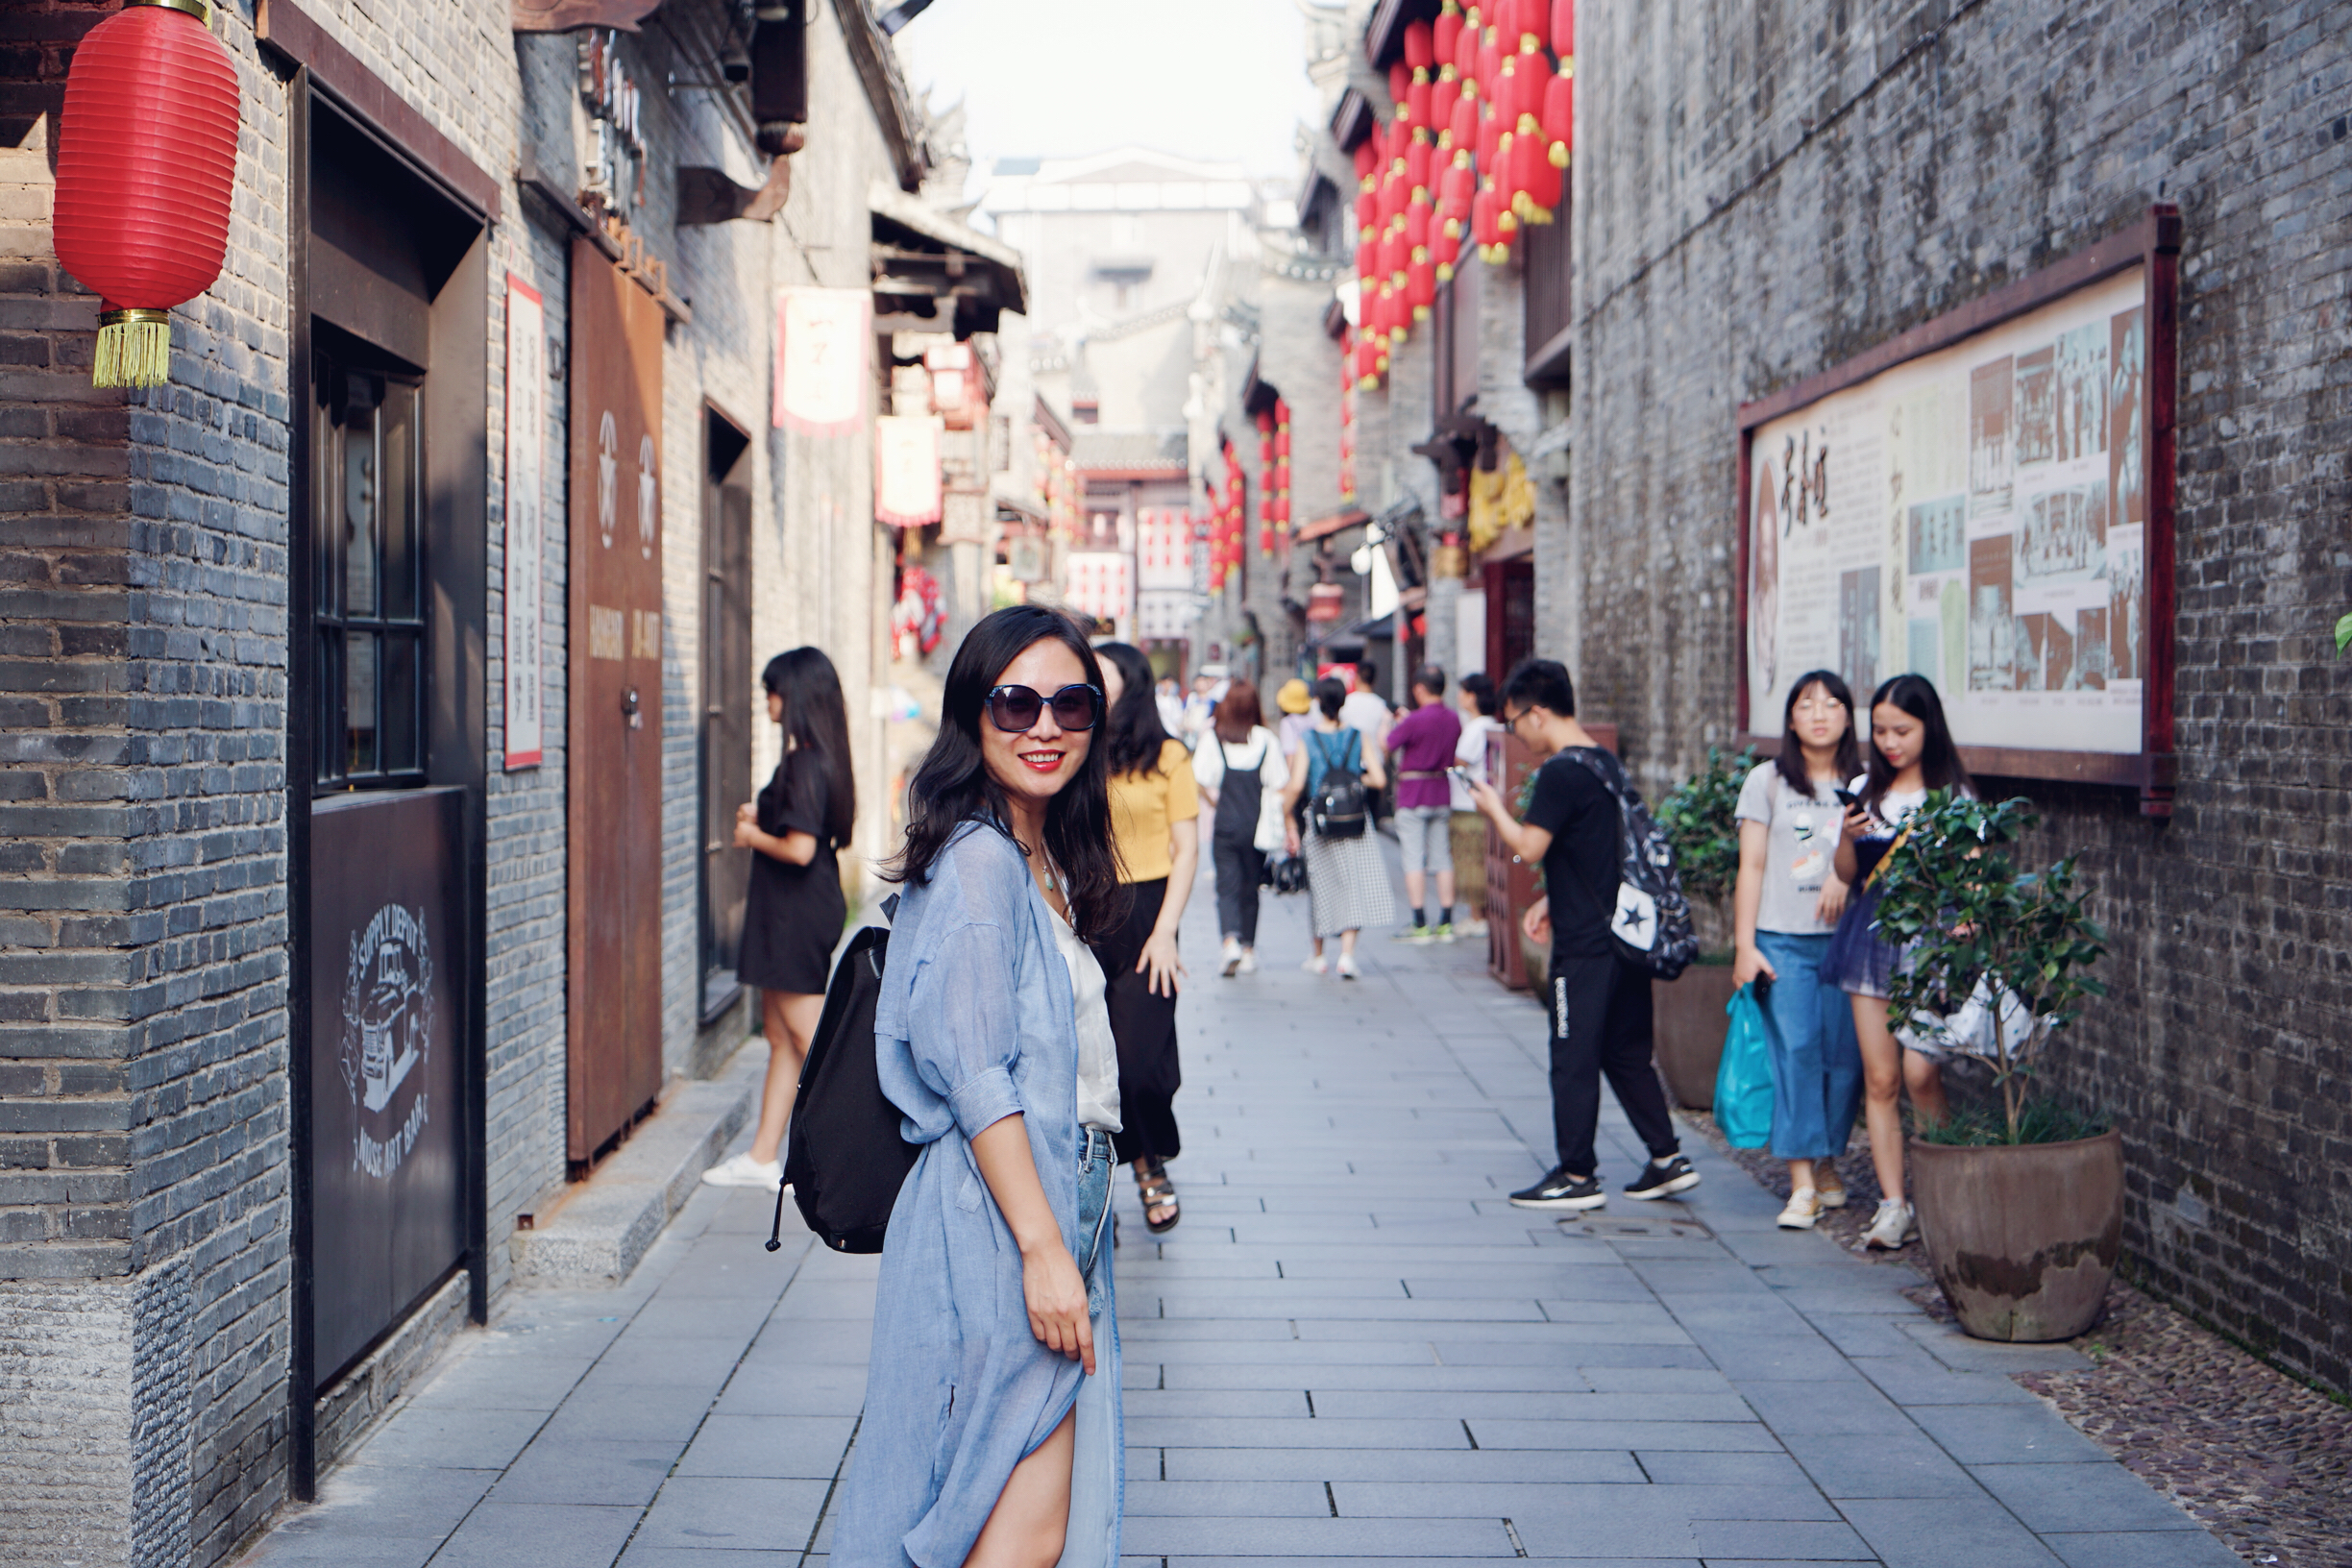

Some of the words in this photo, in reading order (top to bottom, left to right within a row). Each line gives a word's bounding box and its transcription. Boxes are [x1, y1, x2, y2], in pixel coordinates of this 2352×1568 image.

[357, 903, 390, 980] SUPPLY
[391, 903, 418, 957] DEPOT
[358, 1126, 382, 1179] NOSE
[383, 1130, 403, 1176] ART
[404, 1092, 423, 1155] BAR
